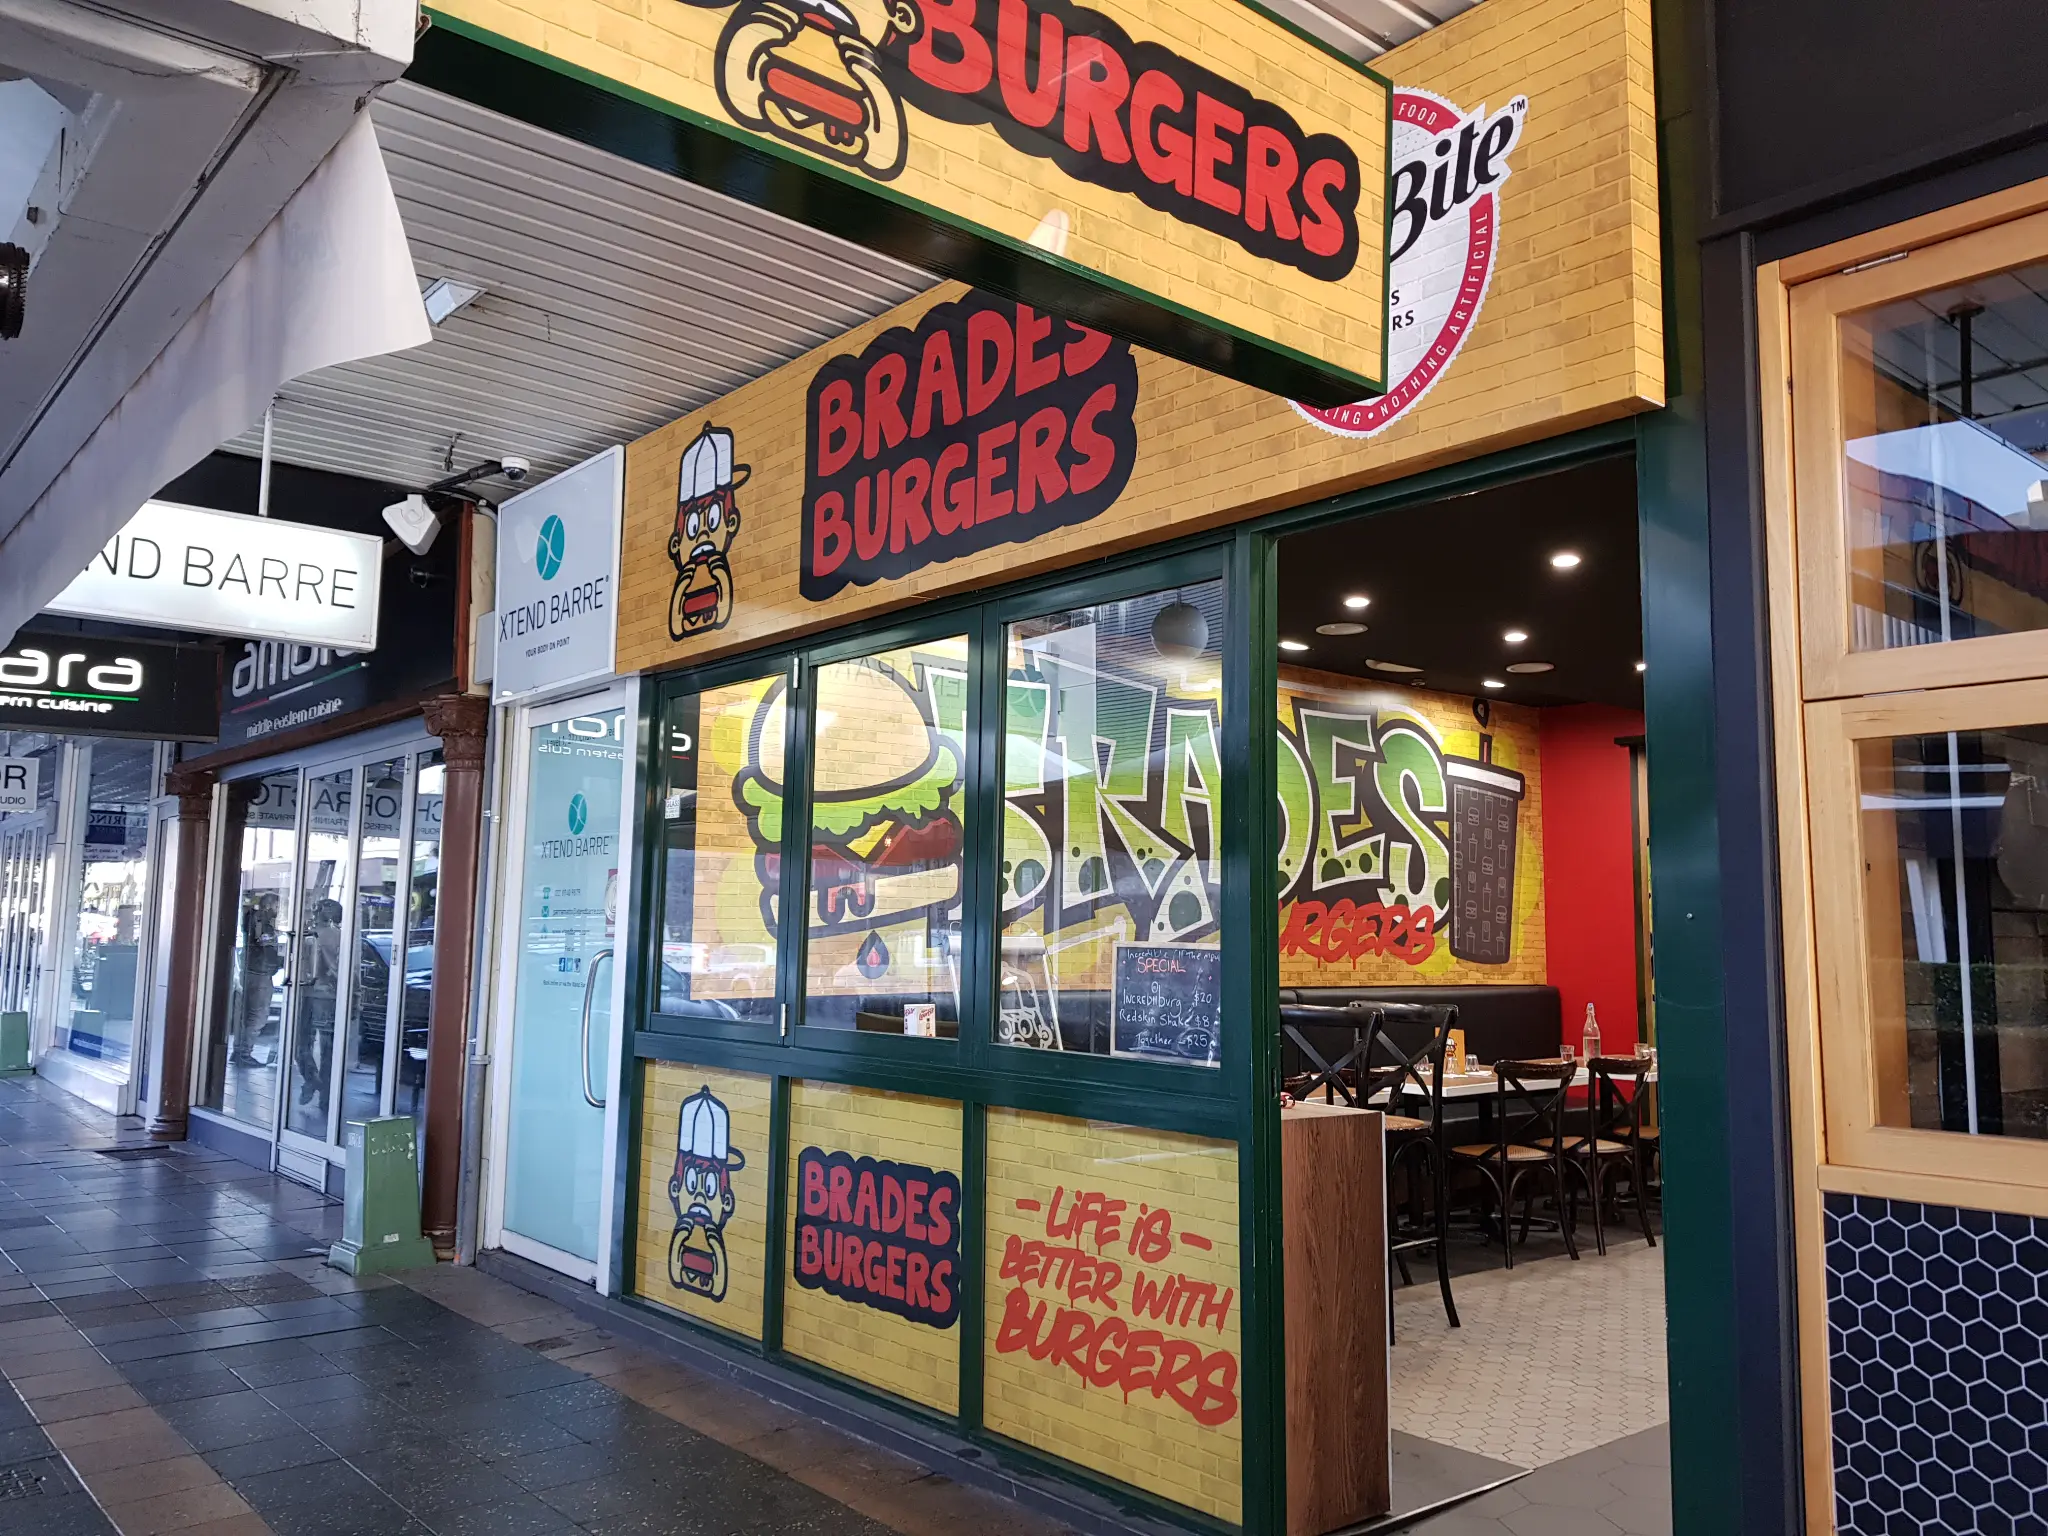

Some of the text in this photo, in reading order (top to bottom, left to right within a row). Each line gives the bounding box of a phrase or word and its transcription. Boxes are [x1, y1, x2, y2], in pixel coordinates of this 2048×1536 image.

[908, 0, 1346, 256] BURGERS
[1399, 102, 1437, 126] FOOD
[1390, 115, 1515, 264] Bite
[1380, 212, 1490, 418] NOTHING ARTIFICIAL
[818, 302, 1112, 477] BRADES
[1314, 406, 1361, 425] LING
[812, 383, 1117, 577] BURGERS
[183, 545, 357, 609] BARRE
[500, 577, 604, 642] XTEND BARRE
[526, 636, 570, 657] YOUR BODY ON POINT
[37, 698, 113, 713] cuisine
[246, 698, 342, 739] middle eastern cuisine
[541, 836, 609, 859] XTEND BARRE
[1137, 957, 1186, 974] SPECIAL
[1120, 1008, 1210, 1028] Redskin Shake $8
[1194, 990, 1212, 1006] $20
[1136, 1032, 1172, 1048] Together
[804, 1160, 952, 1246] BRADES
[801, 1225, 952, 1313] BURGERS
[999, 1235, 1123, 1311] BETTER
[995, 1287, 1238, 1426] BURGERS
